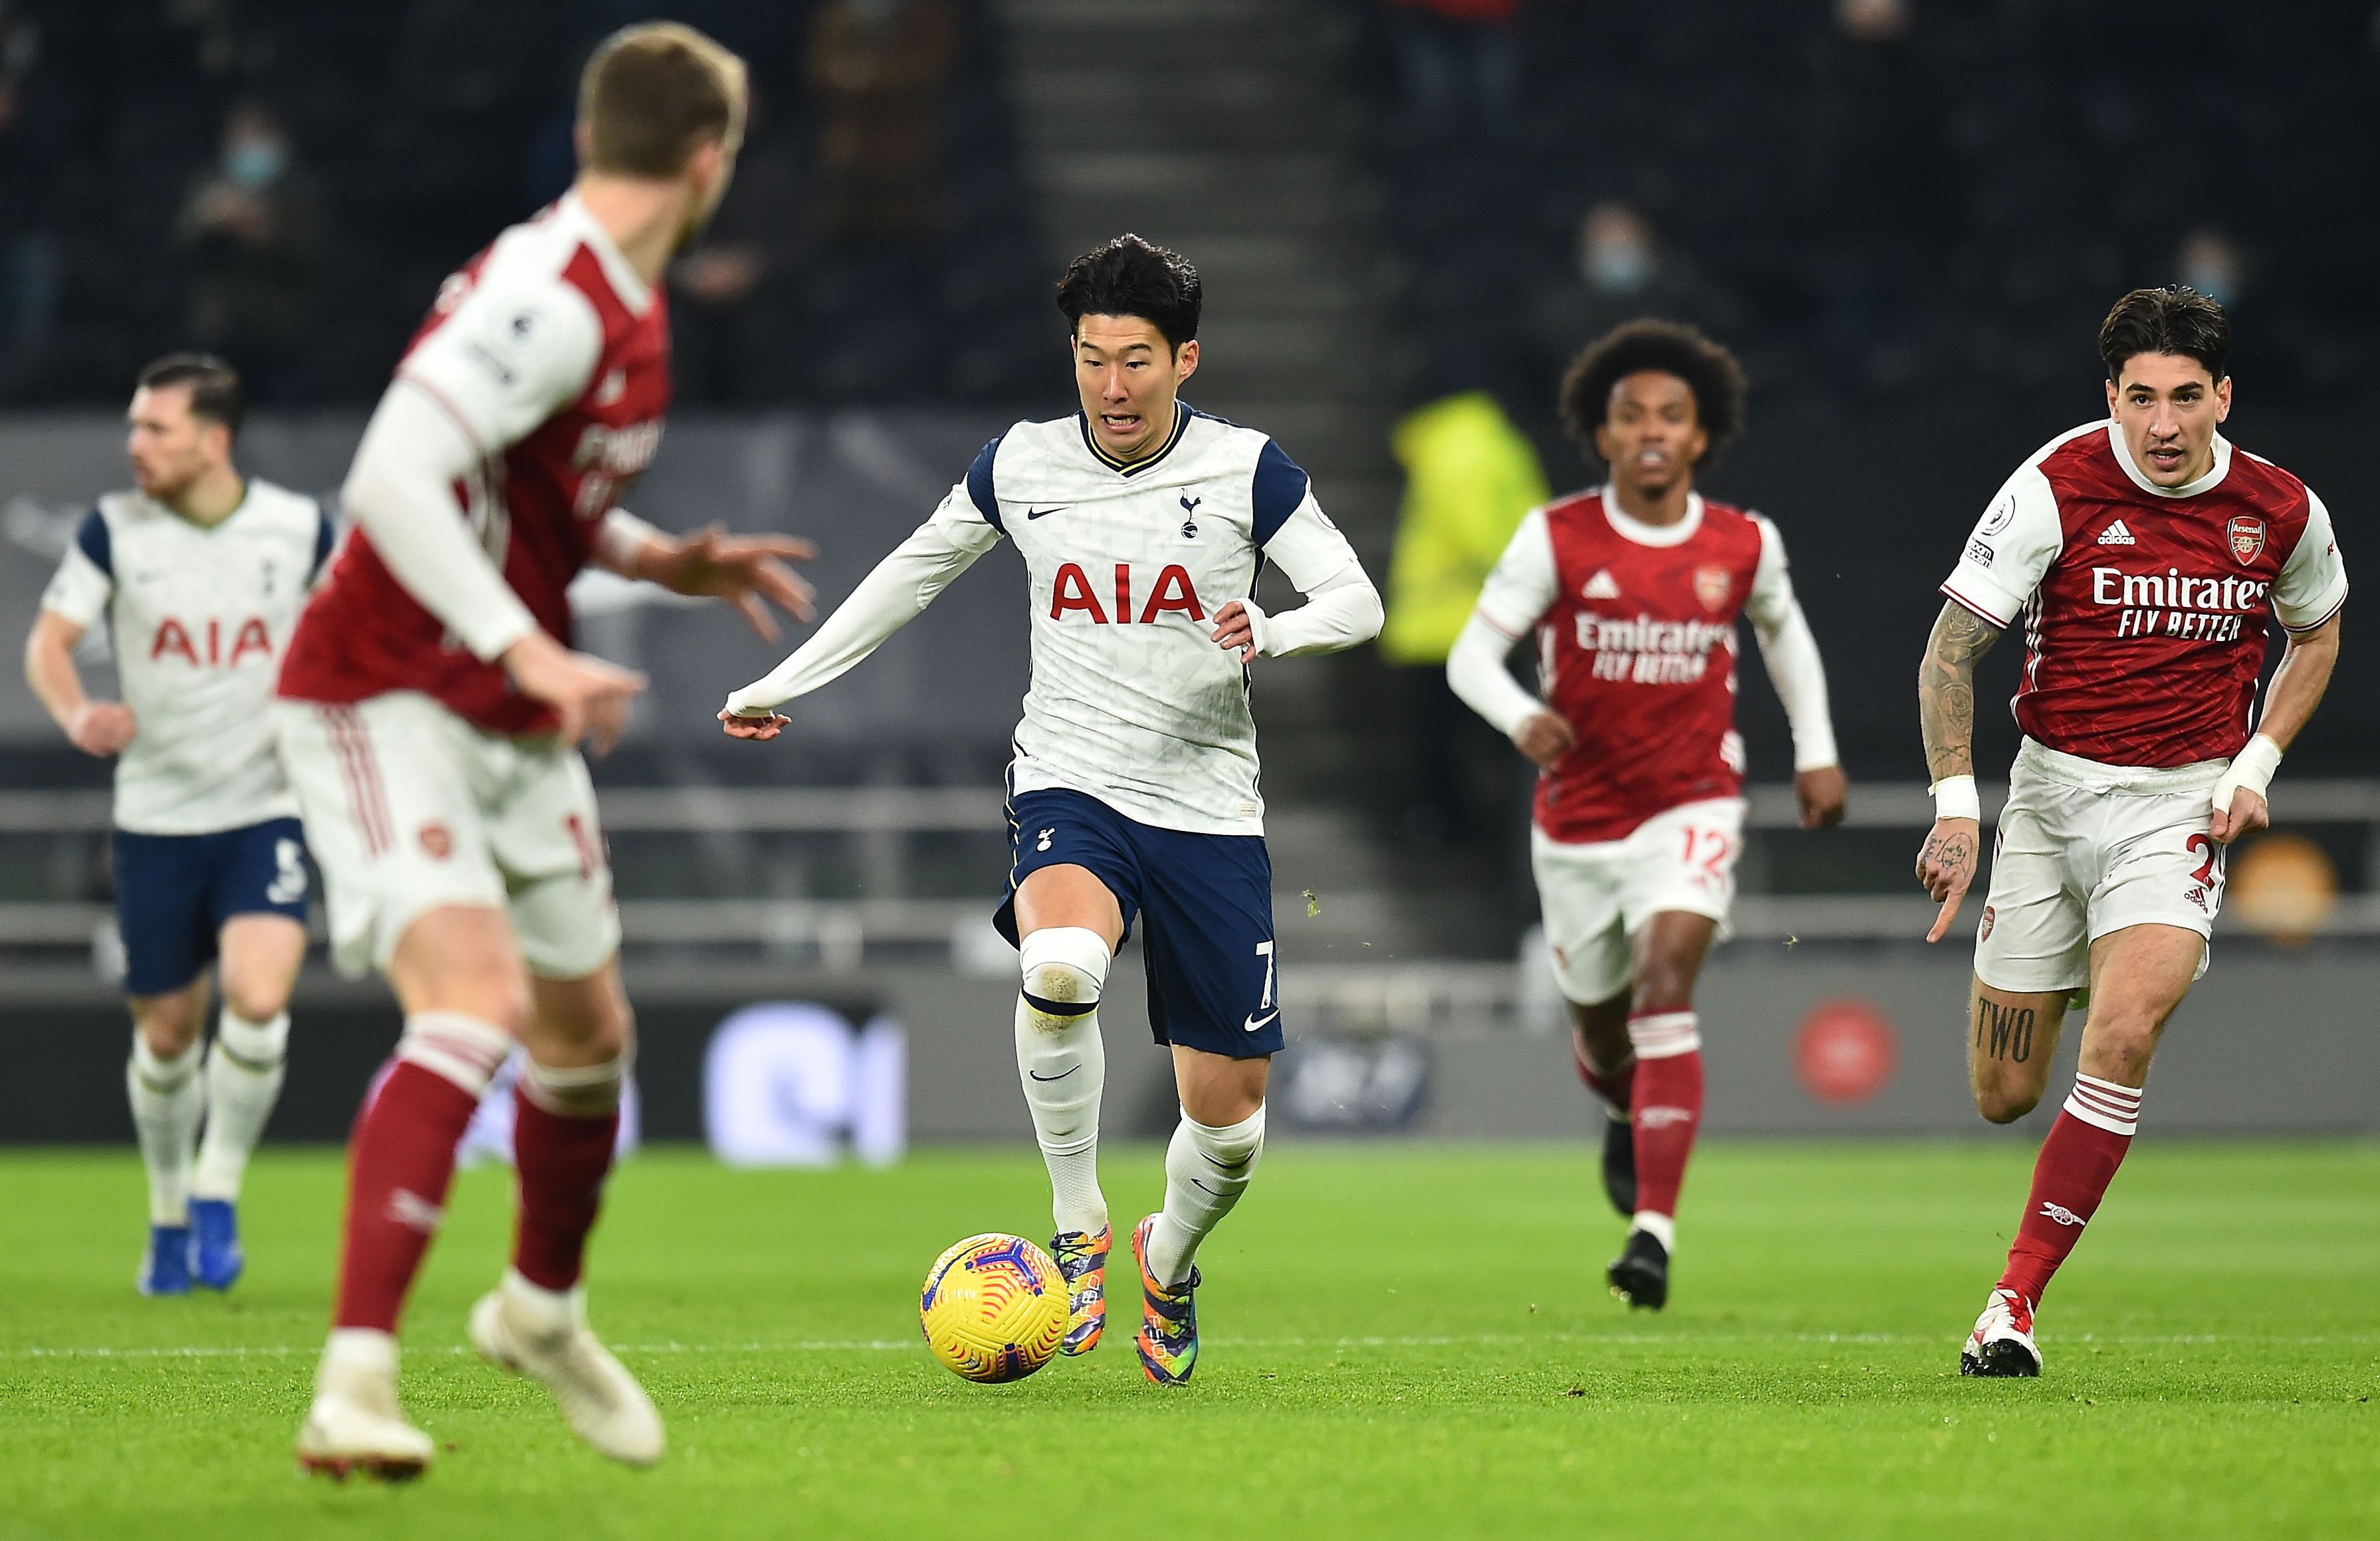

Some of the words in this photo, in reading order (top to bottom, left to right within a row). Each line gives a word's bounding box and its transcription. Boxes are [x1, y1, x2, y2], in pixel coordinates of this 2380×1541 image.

[2097, 535, 2136, 545] adidas
[2232, 524, 2260, 534] Arsenal
[1050, 562, 1206, 624] AIA
[2092, 567, 2269, 610] Emirates
[151, 617, 273, 669] AIA
[2117, 609, 2160, 638] FLY
[2165, 612, 2244, 642] BETTER
[267, 838, 307, 904] 5
[1681, 826, 1728, 878] 12
[2186, 833, 2215, 892] 2
[1256, 940, 1273, 1010] 7
[1976, 997, 2034, 1063] TWO
